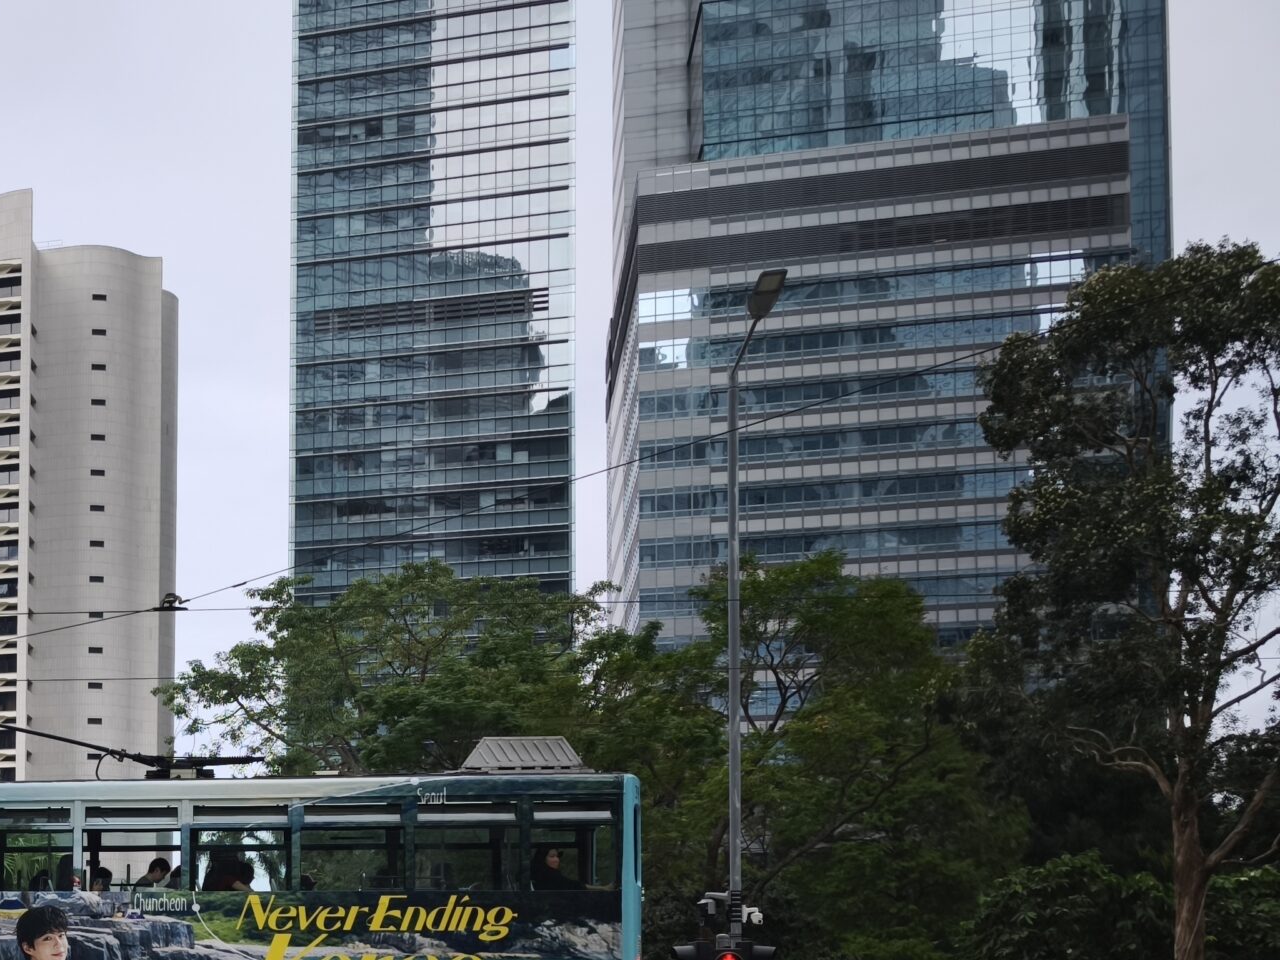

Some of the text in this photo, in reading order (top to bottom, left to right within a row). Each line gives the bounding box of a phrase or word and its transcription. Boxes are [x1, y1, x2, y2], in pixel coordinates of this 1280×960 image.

[417, 786, 447, 804] Seoul
[134, 892, 187, 911] Chuncheon
[235, 894, 518, 942] Never Ending
